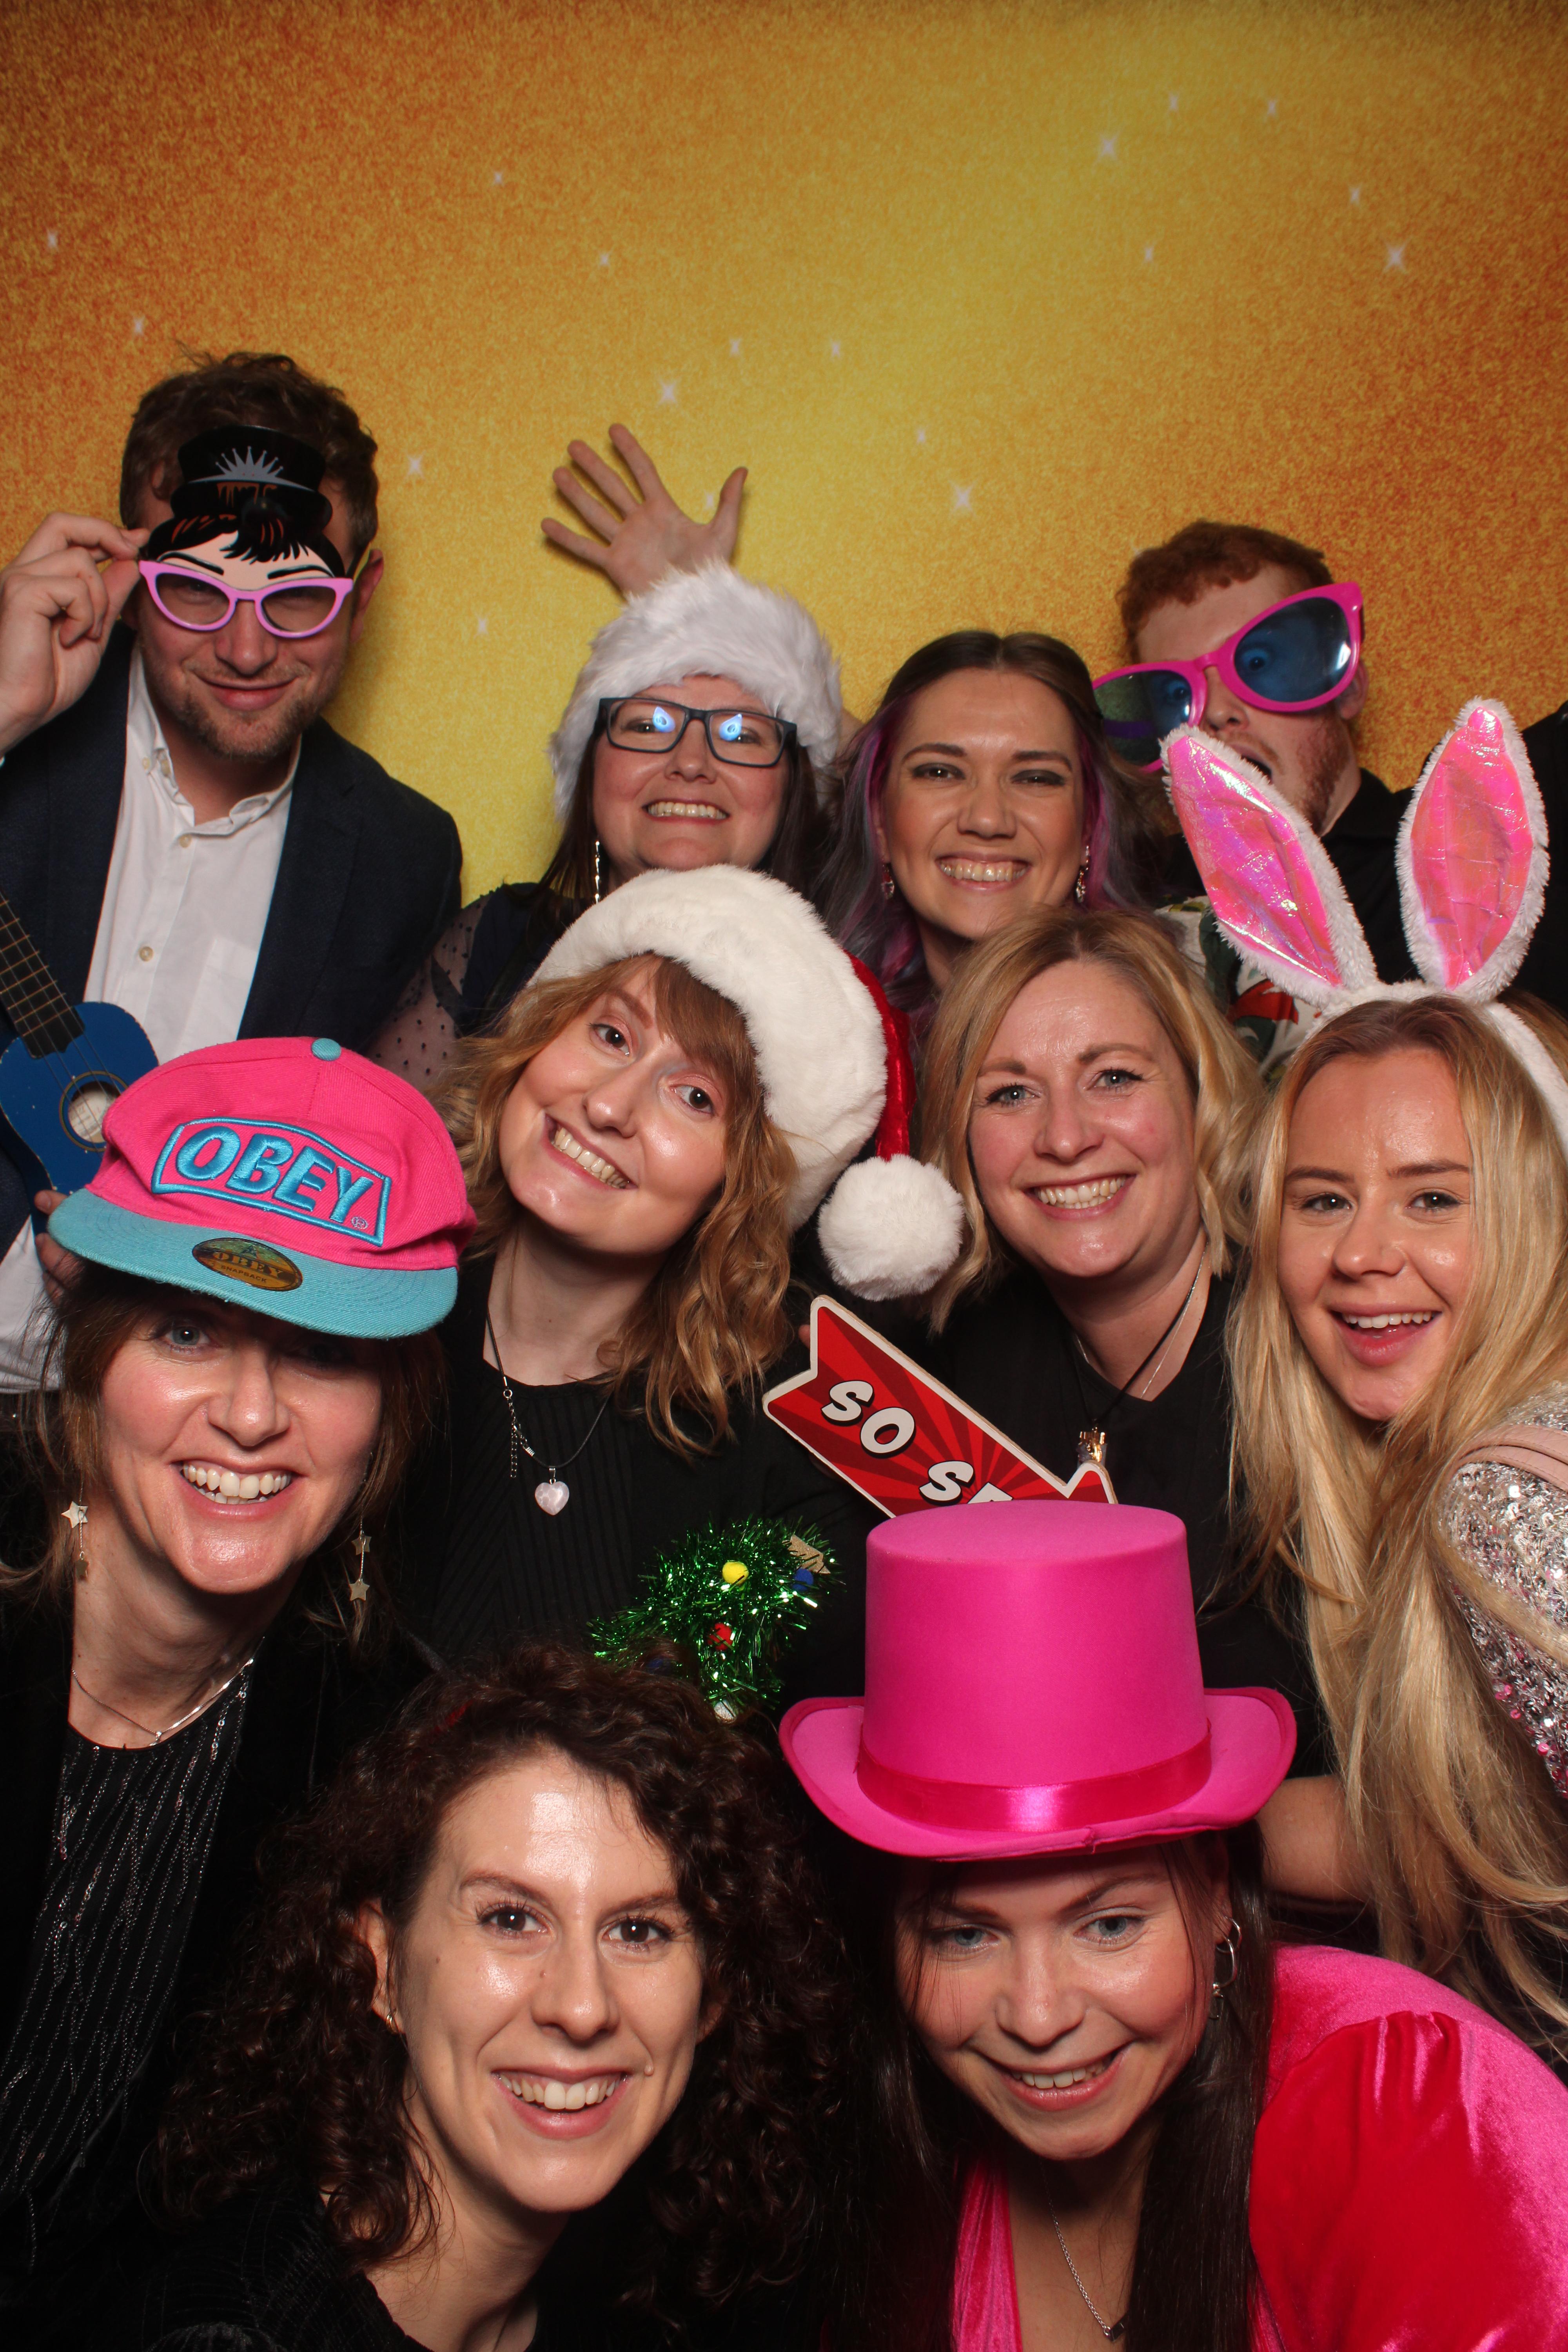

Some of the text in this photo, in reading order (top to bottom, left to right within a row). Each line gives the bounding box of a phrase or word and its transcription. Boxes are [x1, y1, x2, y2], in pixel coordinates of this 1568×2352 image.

[176, 1125, 373, 1223] OBEY
[212, 1252, 283, 1278] OBEY
[220, 1265, 267, 1283] SNAPBACK
[821, 1379, 1014, 1504] SO S
